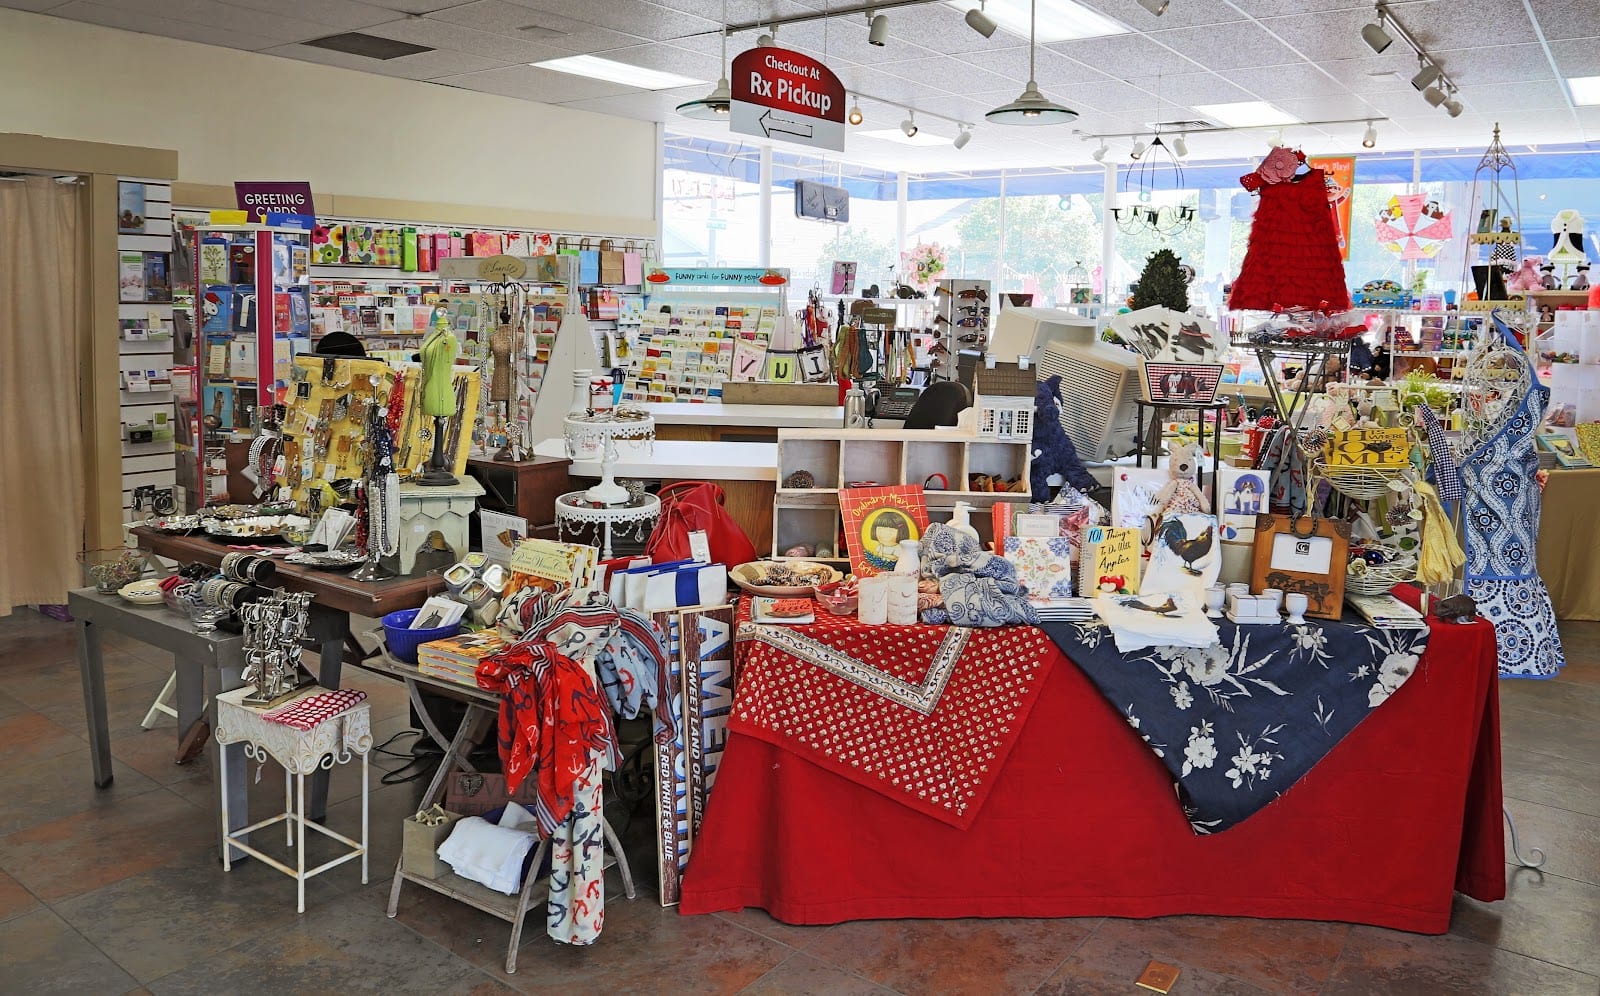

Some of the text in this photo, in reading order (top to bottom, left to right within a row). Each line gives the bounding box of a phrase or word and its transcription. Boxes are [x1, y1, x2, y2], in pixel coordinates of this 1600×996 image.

[765, 55, 821, 81] Checkout At
[750, 71, 831, 116] Rx Pickup
[244, 193, 305, 205] GREETING
[675, 272, 695, 281] FUNNY
[696, 272, 709, 280] cards
[711, 273, 720, 281] for
[720, 273, 743, 283] FUNNY
[851, 493, 919, 518] Ordinary Mary's
[1087, 528, 1132, 543] 101 Things
[1100, 541, 1131, 556] To Do With
[1098, 553, 1130, 574] Apples
[688, 660, 704, 835] SWEET LAND OF LIBER
[660, 754, 671, 778] RED
[662, 780, 672, 818] WHITE
[663, 818, 673, 829] &
[663, 832, 674, 861] BLUE
